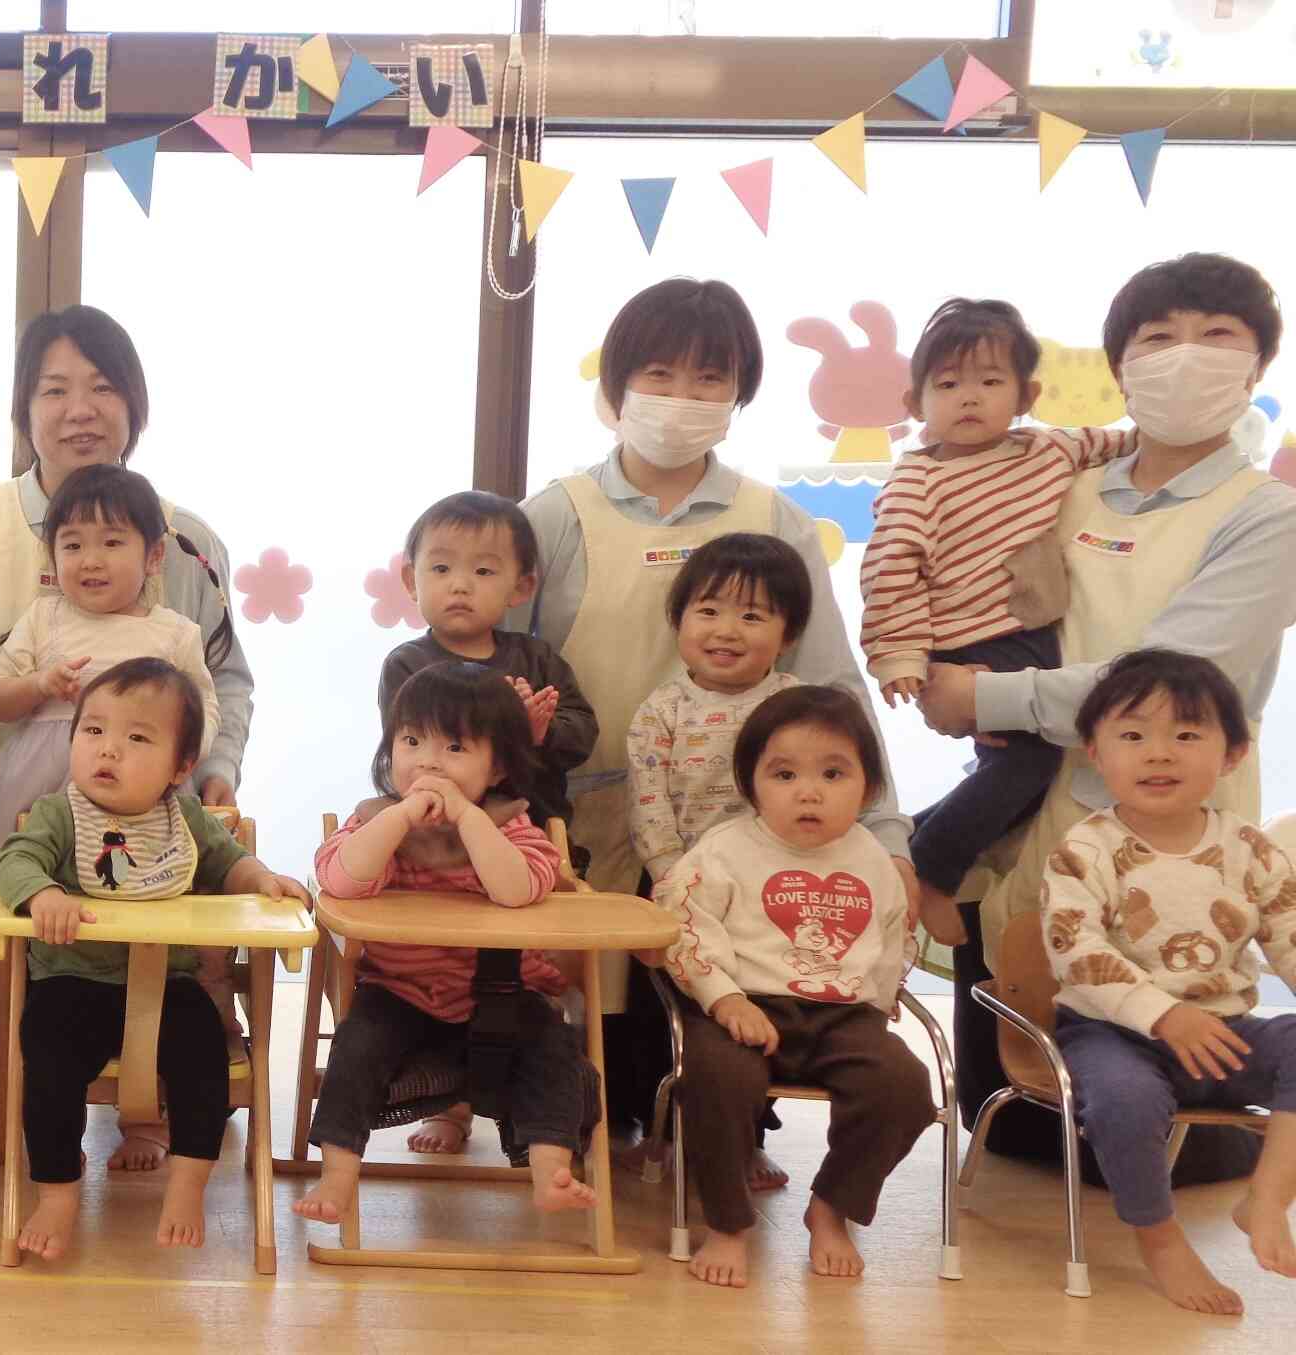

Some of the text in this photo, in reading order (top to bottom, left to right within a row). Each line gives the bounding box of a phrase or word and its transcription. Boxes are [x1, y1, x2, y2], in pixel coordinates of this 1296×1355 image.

[766, 891, 870, 911] LOVE IS ALWAYS
[798, 905, 846, 921] JUSTICE
